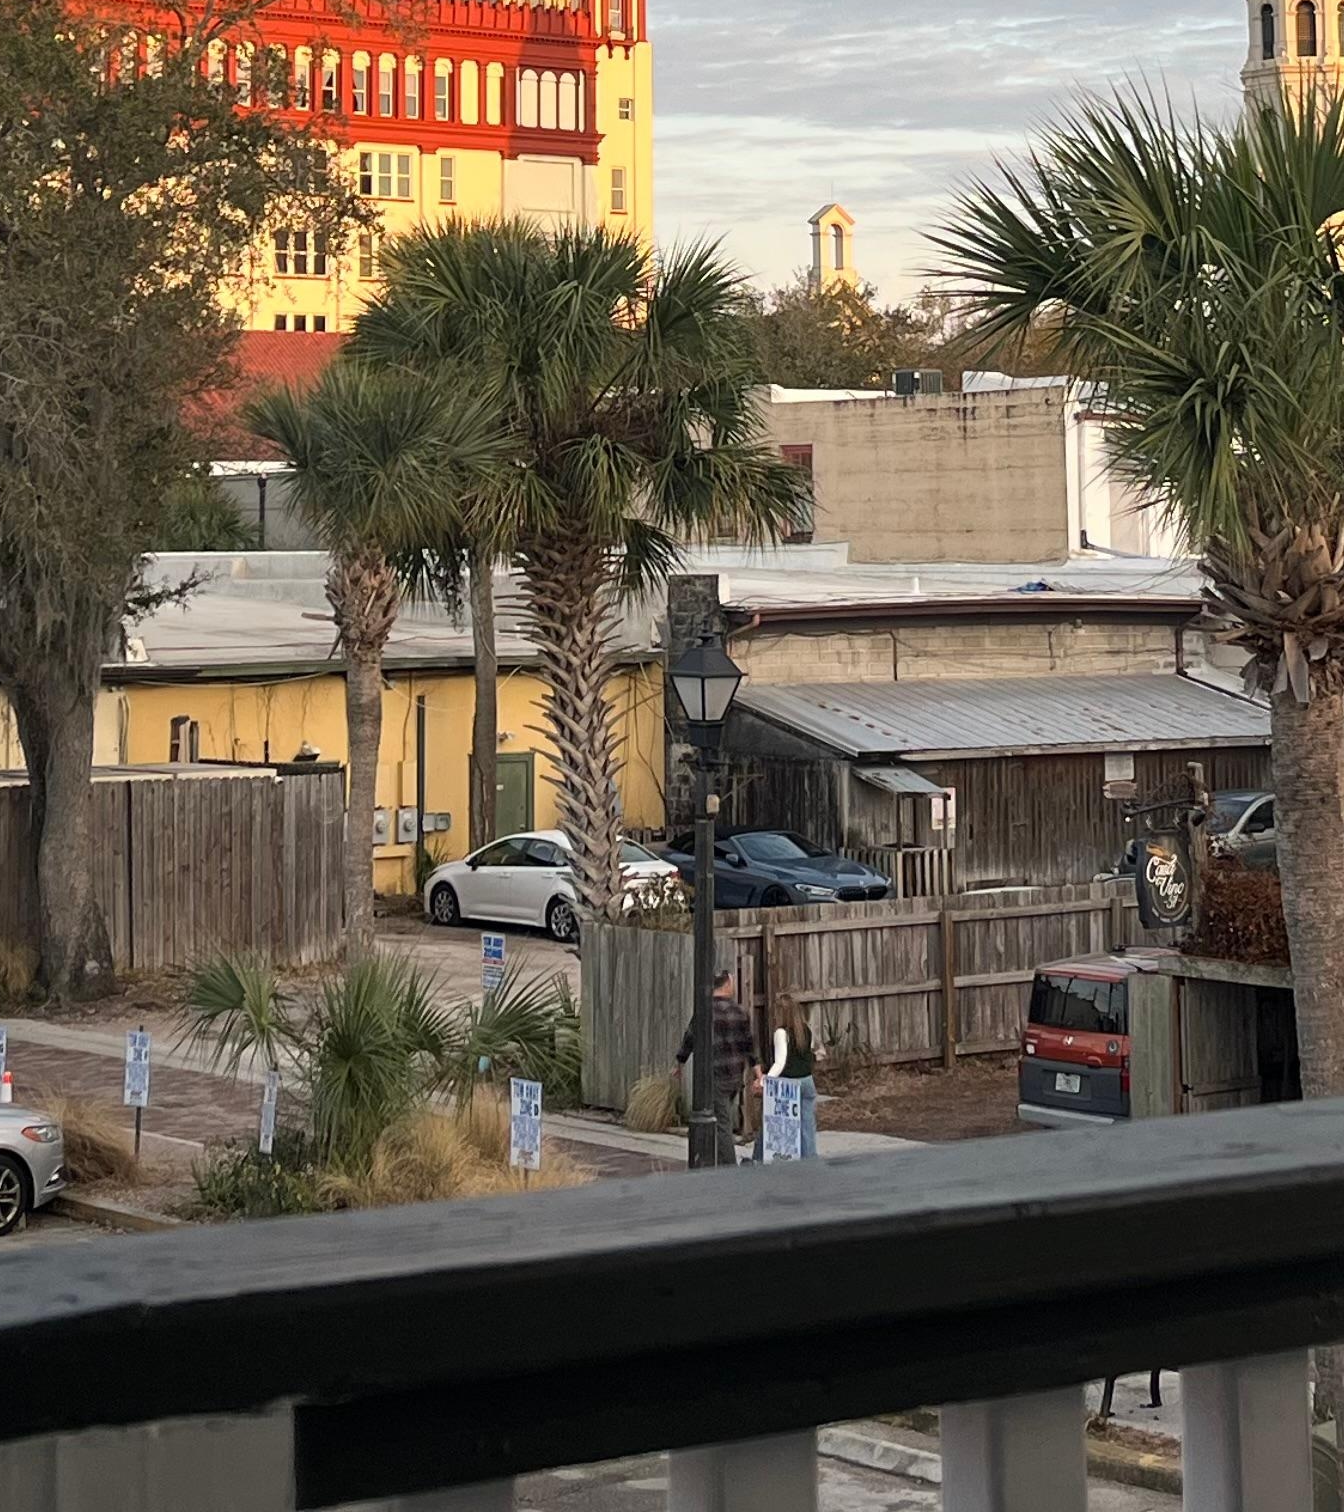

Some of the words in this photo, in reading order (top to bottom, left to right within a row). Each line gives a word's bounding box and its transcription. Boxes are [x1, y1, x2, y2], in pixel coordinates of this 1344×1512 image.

[766, 1077, 780, 1097] TOW
[780, 1080, 798, 1101] AWAY
[774, 1097, 790, 1117] ZONE
[792, 1103, 798, 1117] C
